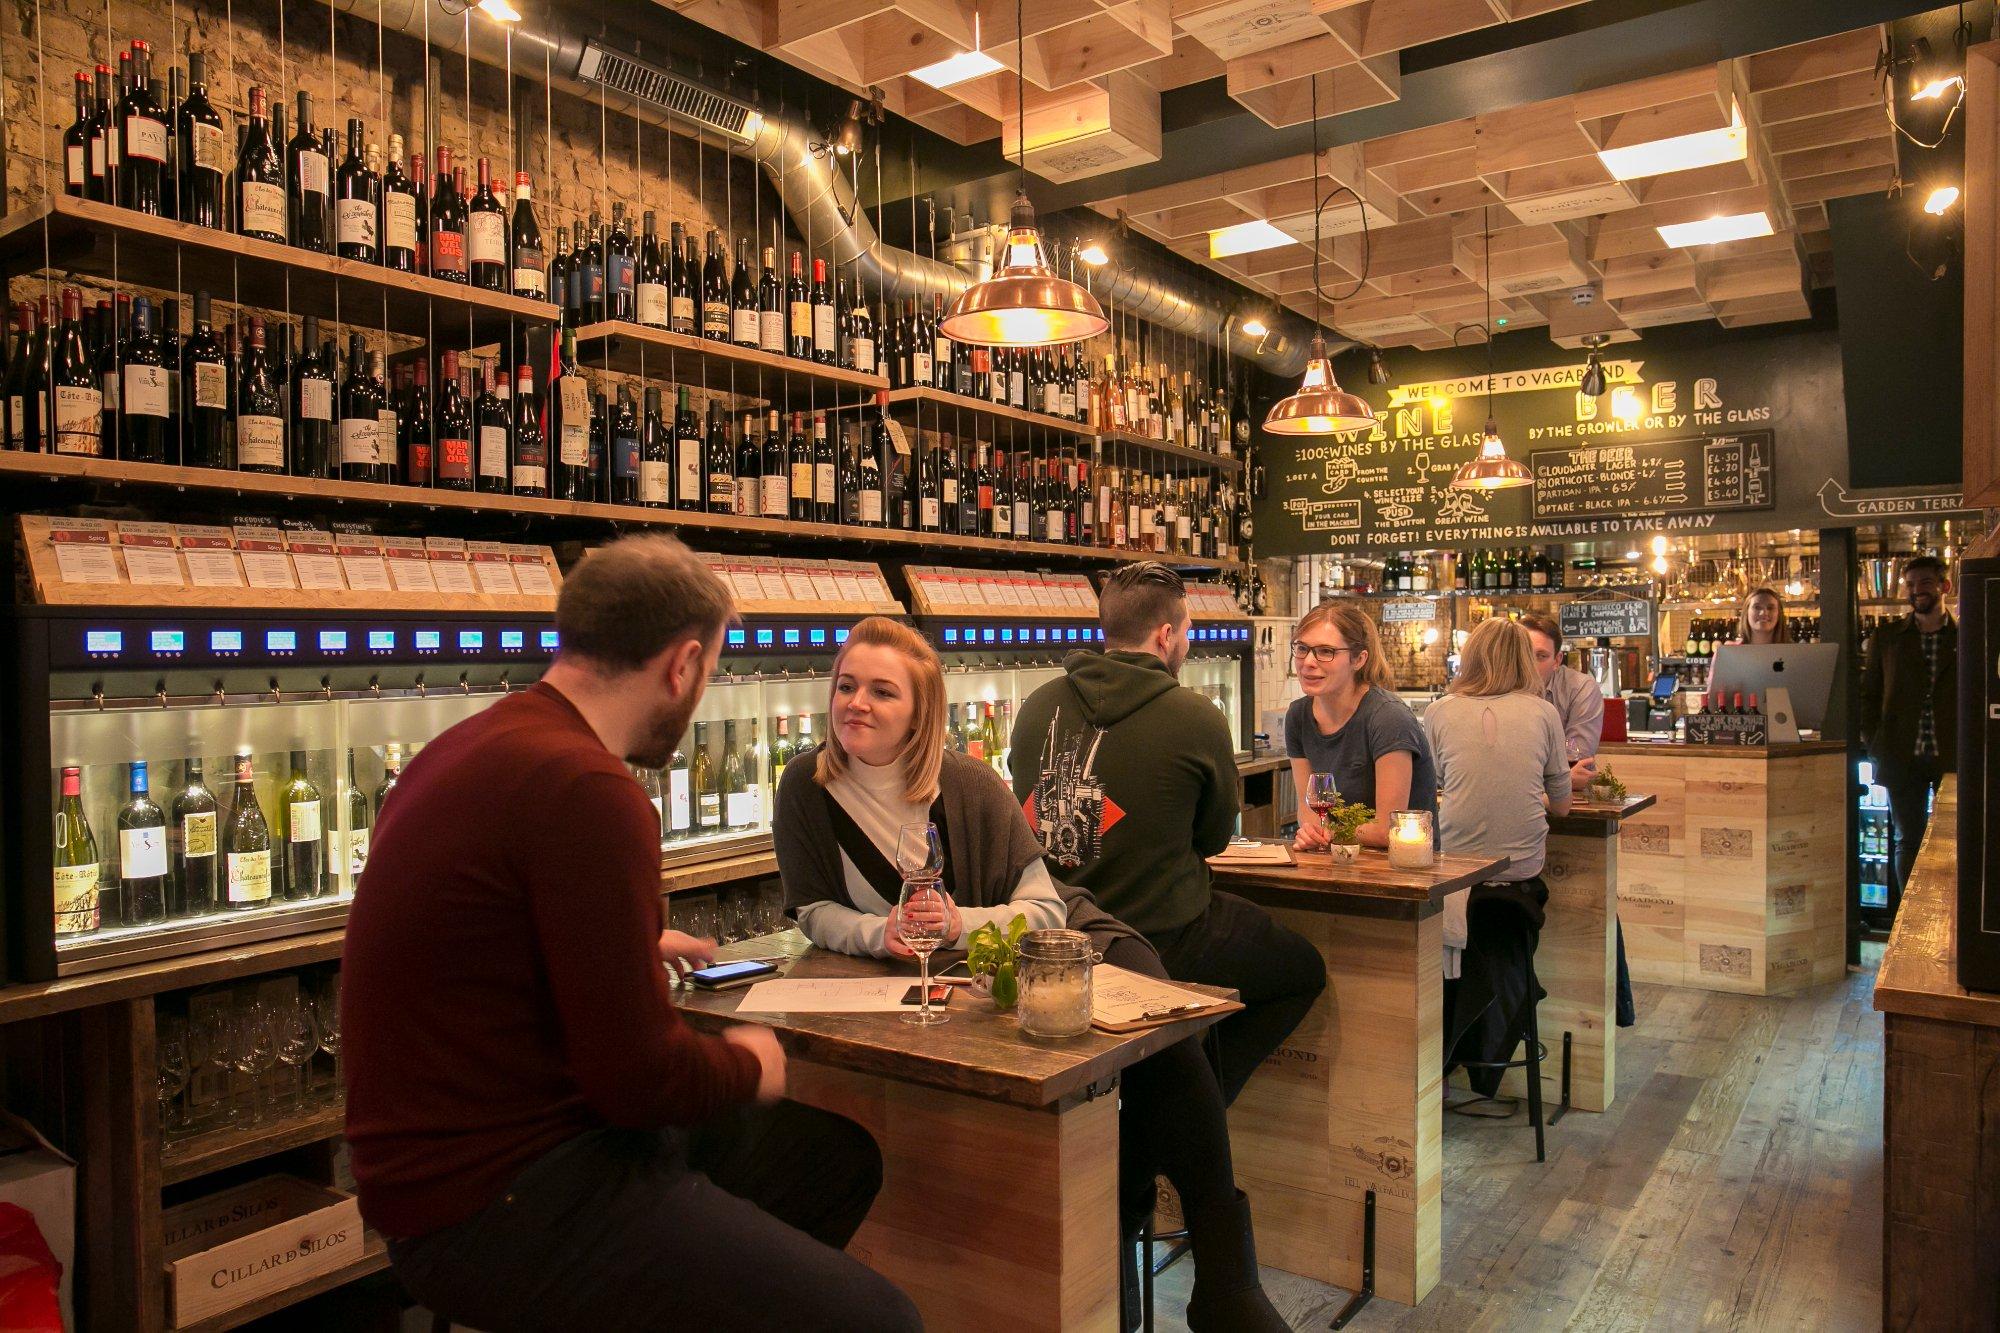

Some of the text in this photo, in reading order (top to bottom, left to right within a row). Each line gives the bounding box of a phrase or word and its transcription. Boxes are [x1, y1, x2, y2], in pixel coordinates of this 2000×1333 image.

[438, 232, 461, 243] MAR
[439, 241, 461, 249] VEL
[440, 247, 463, 257] OUS
[1408, 365, 1624, 398] WELCOME TO VAGABND
[1529, 406, 1771, 440] BY THE GROWLER OR BY THE GLASS
[446, 440, 468, 450] MAR
[1301, 447, 1323, 461] 100
[1330, 443, 1373, 458] WINES
[1380, 440, 1397, 454] BY
[1402, 437, 1435, 452] THE
[446, 448, 466, 456] VEL
[1568, 447, 1634, 465] THE BEER
[446, 455, 469, 464] OUS
[1708, 452, 1739, 465] £4.30
[1407, 467, 1416, 475] 2.
[1431, 464, 1452, 472] GRAB
[1538, 462, 1597, 478] CLOUDWATER
[1606, 458, 1637, 471] LAGER
[1356, 475, 1389, 483] COUNTER
[1537, 474, 1595, 490] NORTHCOTE
[1600, 470, 1636, 482] BLONDE
[1708, 475, 1739, 488] £4.60
[1373, 488, 1404, 498] SELECT
[1405, 486, 1425, 496] YOUR
[1537, 487, 1582, 502] PARTISAN
[1589, 486, 1602, 495] IPA
[1708, 488, 1739, 501] £5.40
[1292, 500, 1306, 509] POP
[1374, 497, 1394, 505] WINE
[1401, 494, 1423, 503] SIZE
[1283, 502, 1291, 510] 3.
[1538, 502, 1575, 515] OPTARE
[1585, 500, 1613, 510] BLACK
[1617, 498, 1631, 507] IPA
[1857, 500, 1915, 514] GARDEN
[1385, 508, 1409, 518] PUSH
[233, 516, 272, 525] FREDDIE'S
[1315, 520, 1328, 528] THE
[1331, 518, 1359, 527] MACHINE
[1374, 518, 1426, 528] THE BUTTON
[1435, 514, 1489, 525] GREAT WINE
[332, 522, 372, 532] CHRISTINE'S
[1331, 514, 1715, 546] DONT FORGET! EVERYTHING IS AVAILABLE TO TAKE AWAY
[1591, 603, 1621, 611] PROSECCO
[1591, 609, 1625, 617] CHAMPAGNE
[1579, 619, 1623, 628] CHAMPAGNE
[1580, 625, 1625, 635] BY THE BOTTLE
[163, 1218, 215, 1247] ILLAR
[232, 1199, 280, 1223] SILOS
[210, 1253, 283, 1290] CILLAR
[299, 1228, 348, 1258] SILOS
